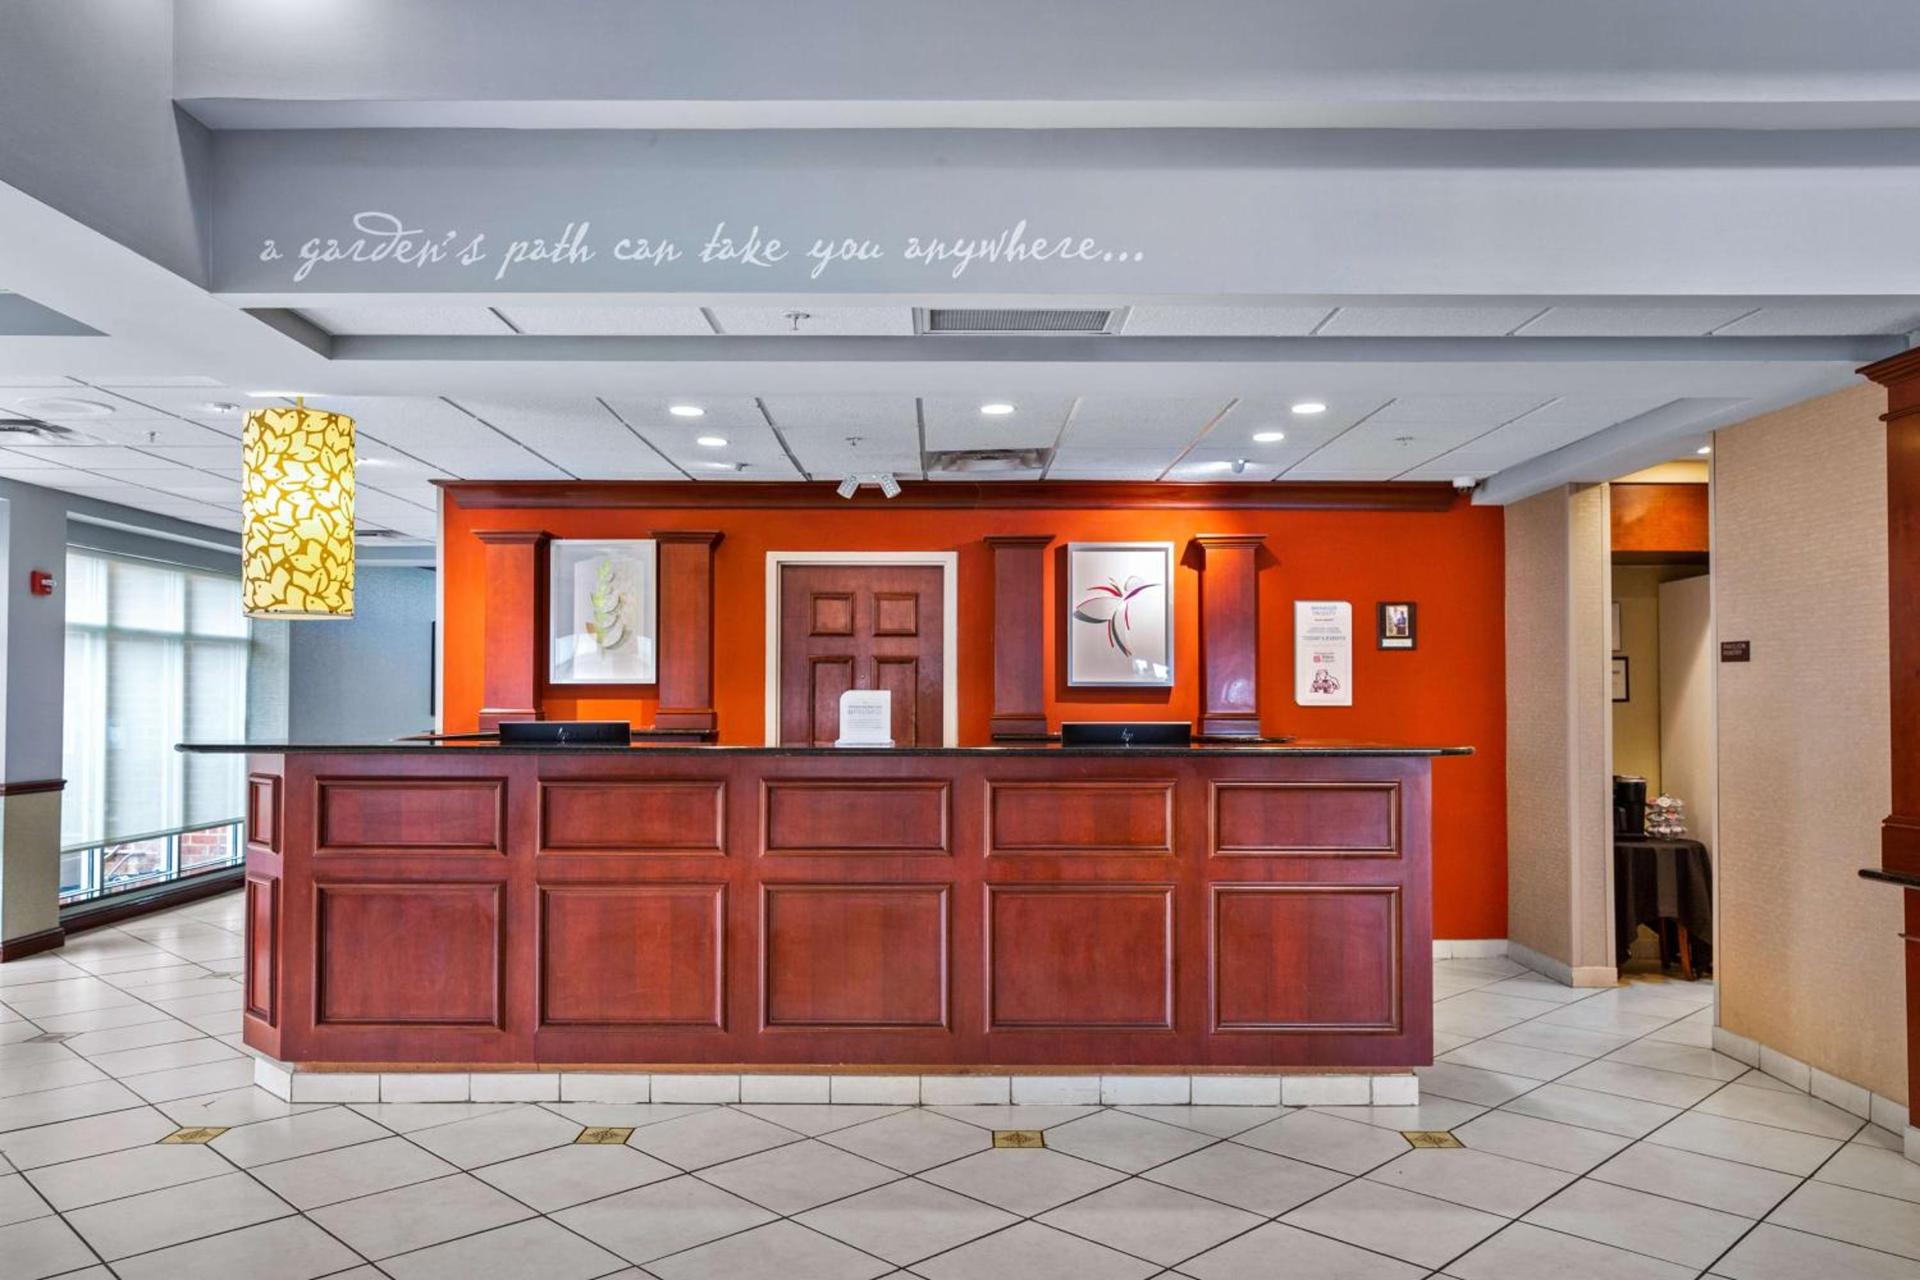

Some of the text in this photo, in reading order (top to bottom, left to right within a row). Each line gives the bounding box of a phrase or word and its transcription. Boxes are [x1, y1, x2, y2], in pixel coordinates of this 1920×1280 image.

[260, 211, 1144, 283] a garden's path can take you anywhere...
